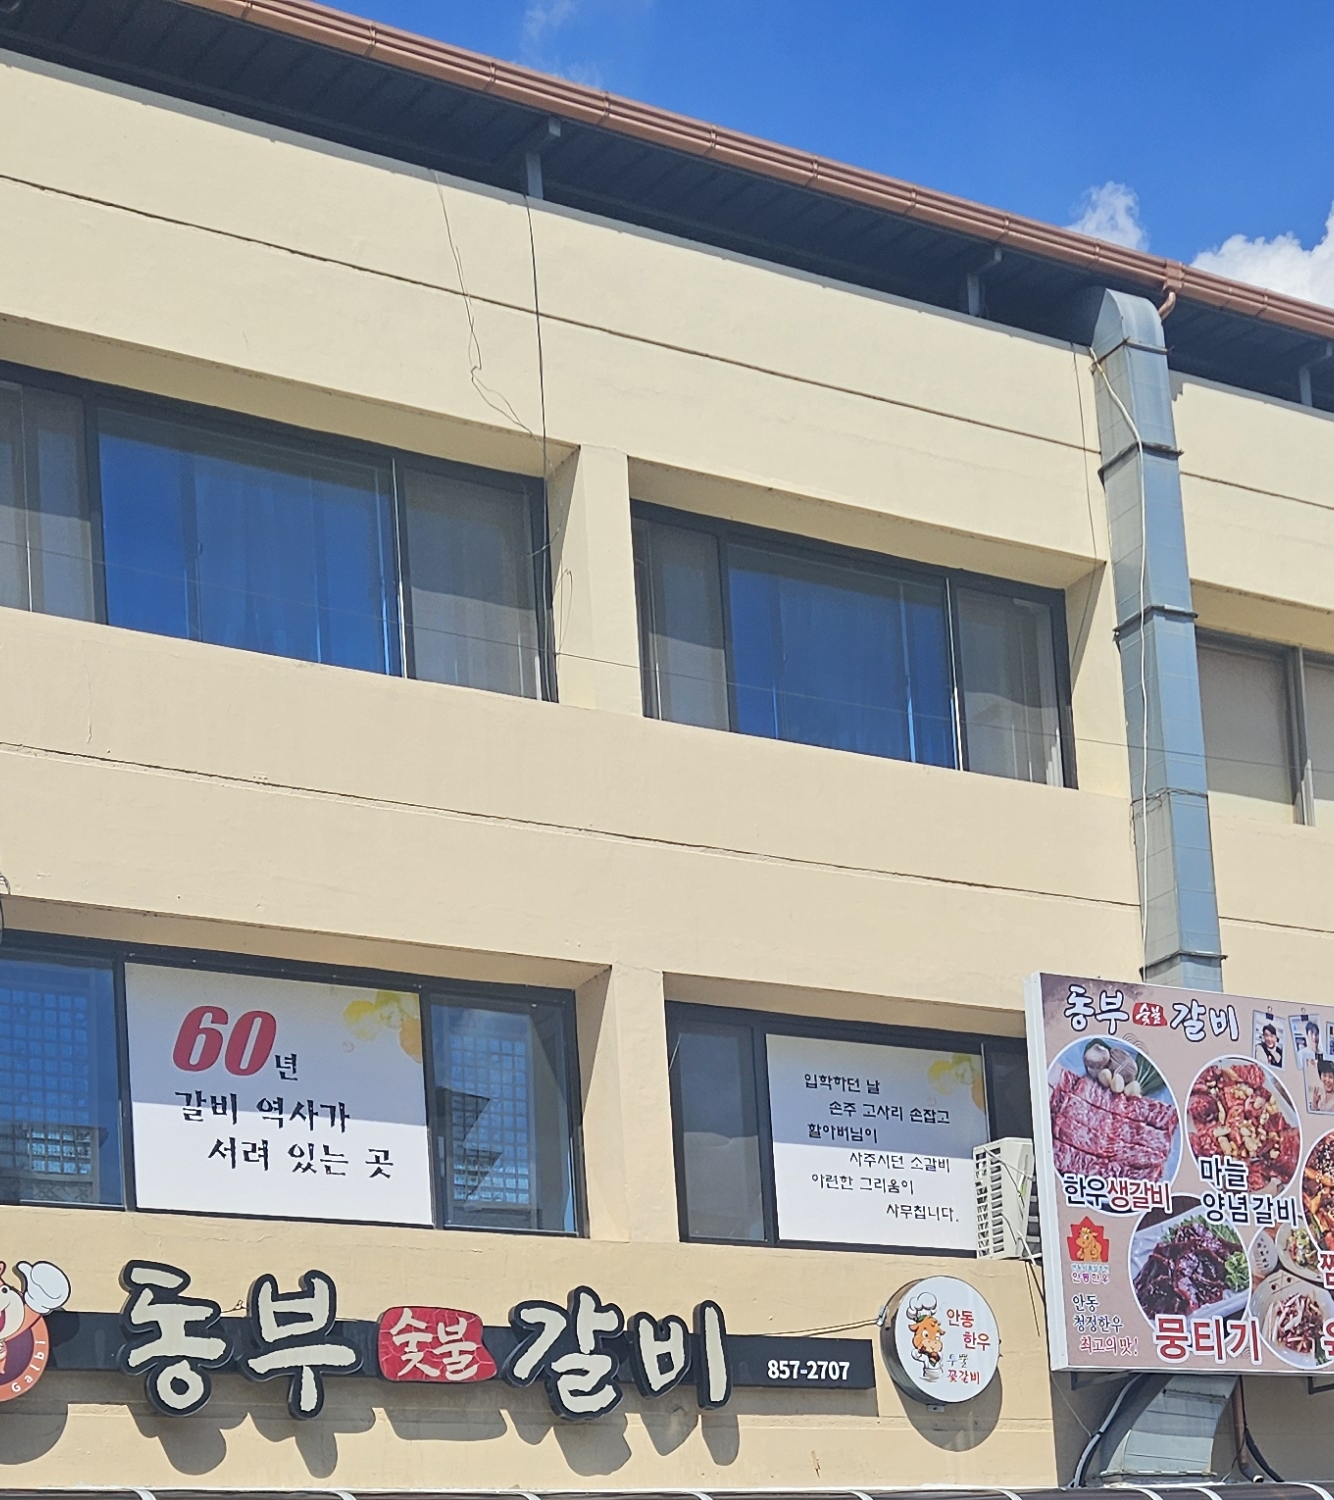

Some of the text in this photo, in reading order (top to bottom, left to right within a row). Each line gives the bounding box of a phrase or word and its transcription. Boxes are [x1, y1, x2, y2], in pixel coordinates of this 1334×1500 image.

[1065, 984, 1129, 1033] 동부
[1171, 999, 1239, 1042] 갈비
[804, 1073, 880, 1094] 입학하던 날
[175, 1090, 350, 1133] 갈비 역사가
[829, 1101, 950, 1125] 손주 고사리 손잡고
[208, 1137, 394, 1179] 서려 있는 곳
[850, 1152, 950, 1173] 사주시던 소갈비
[811, 1174, 914, 1195] 아련한 그리움이
[1199, 1156, 1248, 1191] 마늘
[1064, 1173, 1171, 1212] 한우생갈비
[886, 1204, 959, 1222] 사무칩니다.
[1072, 1294, 1099, 1312] 안동
[947, 1309, 974, 1328] 안동
[1074, 1316, 1124, 1333] 청정한우
[123, 1263, 850, 1417] 동부 숯불 갈비 857-2707
[963, 1331, 990, 1351] 한우
[1080, 1336, 1117, 1354] 최고의
[1155, 1317, 1261, 1363] 뭉티기
[11, 1340, 46, 1393] Galbi
